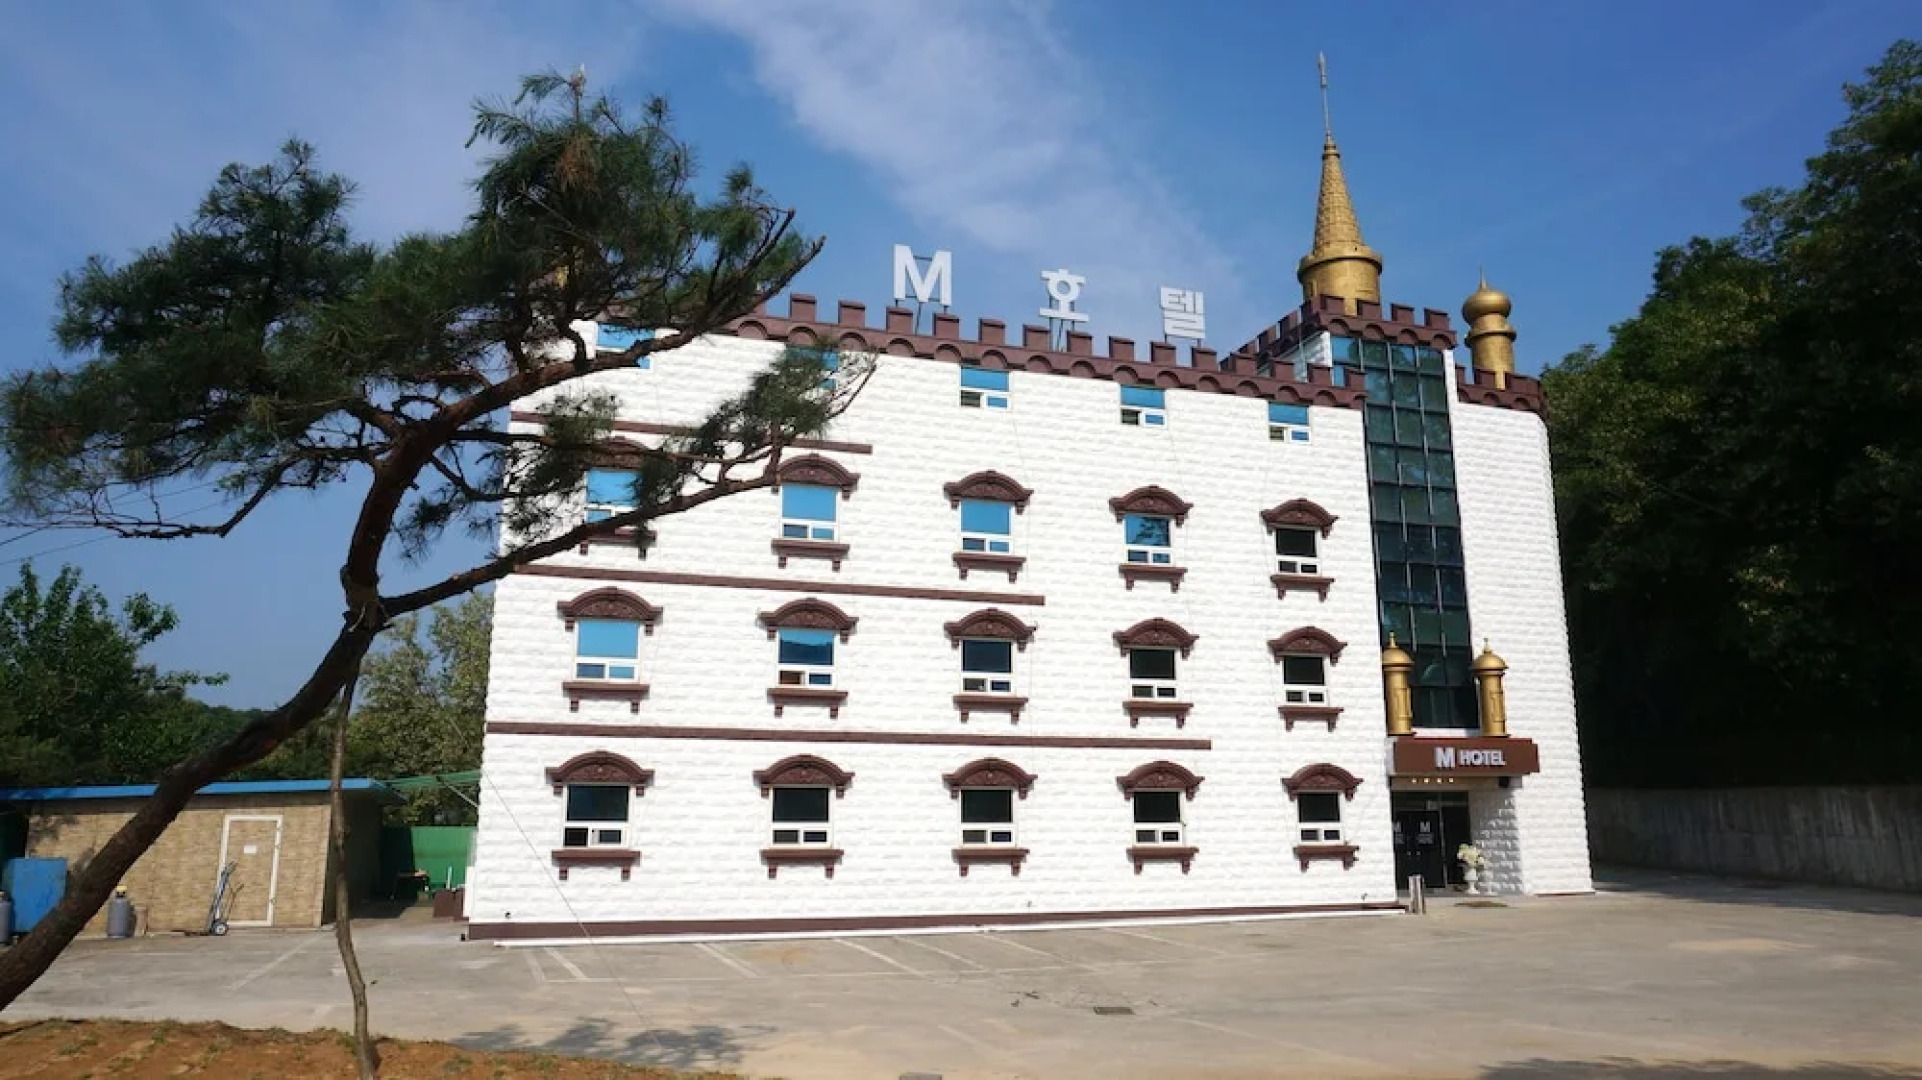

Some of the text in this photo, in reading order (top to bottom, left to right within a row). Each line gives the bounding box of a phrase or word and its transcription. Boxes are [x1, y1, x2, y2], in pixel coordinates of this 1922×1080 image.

[894, 244, 1205, 339] M 호텔
[1435, 746, 1506, 768] M HOTEL
[1420, 821, 1430, 832] M
